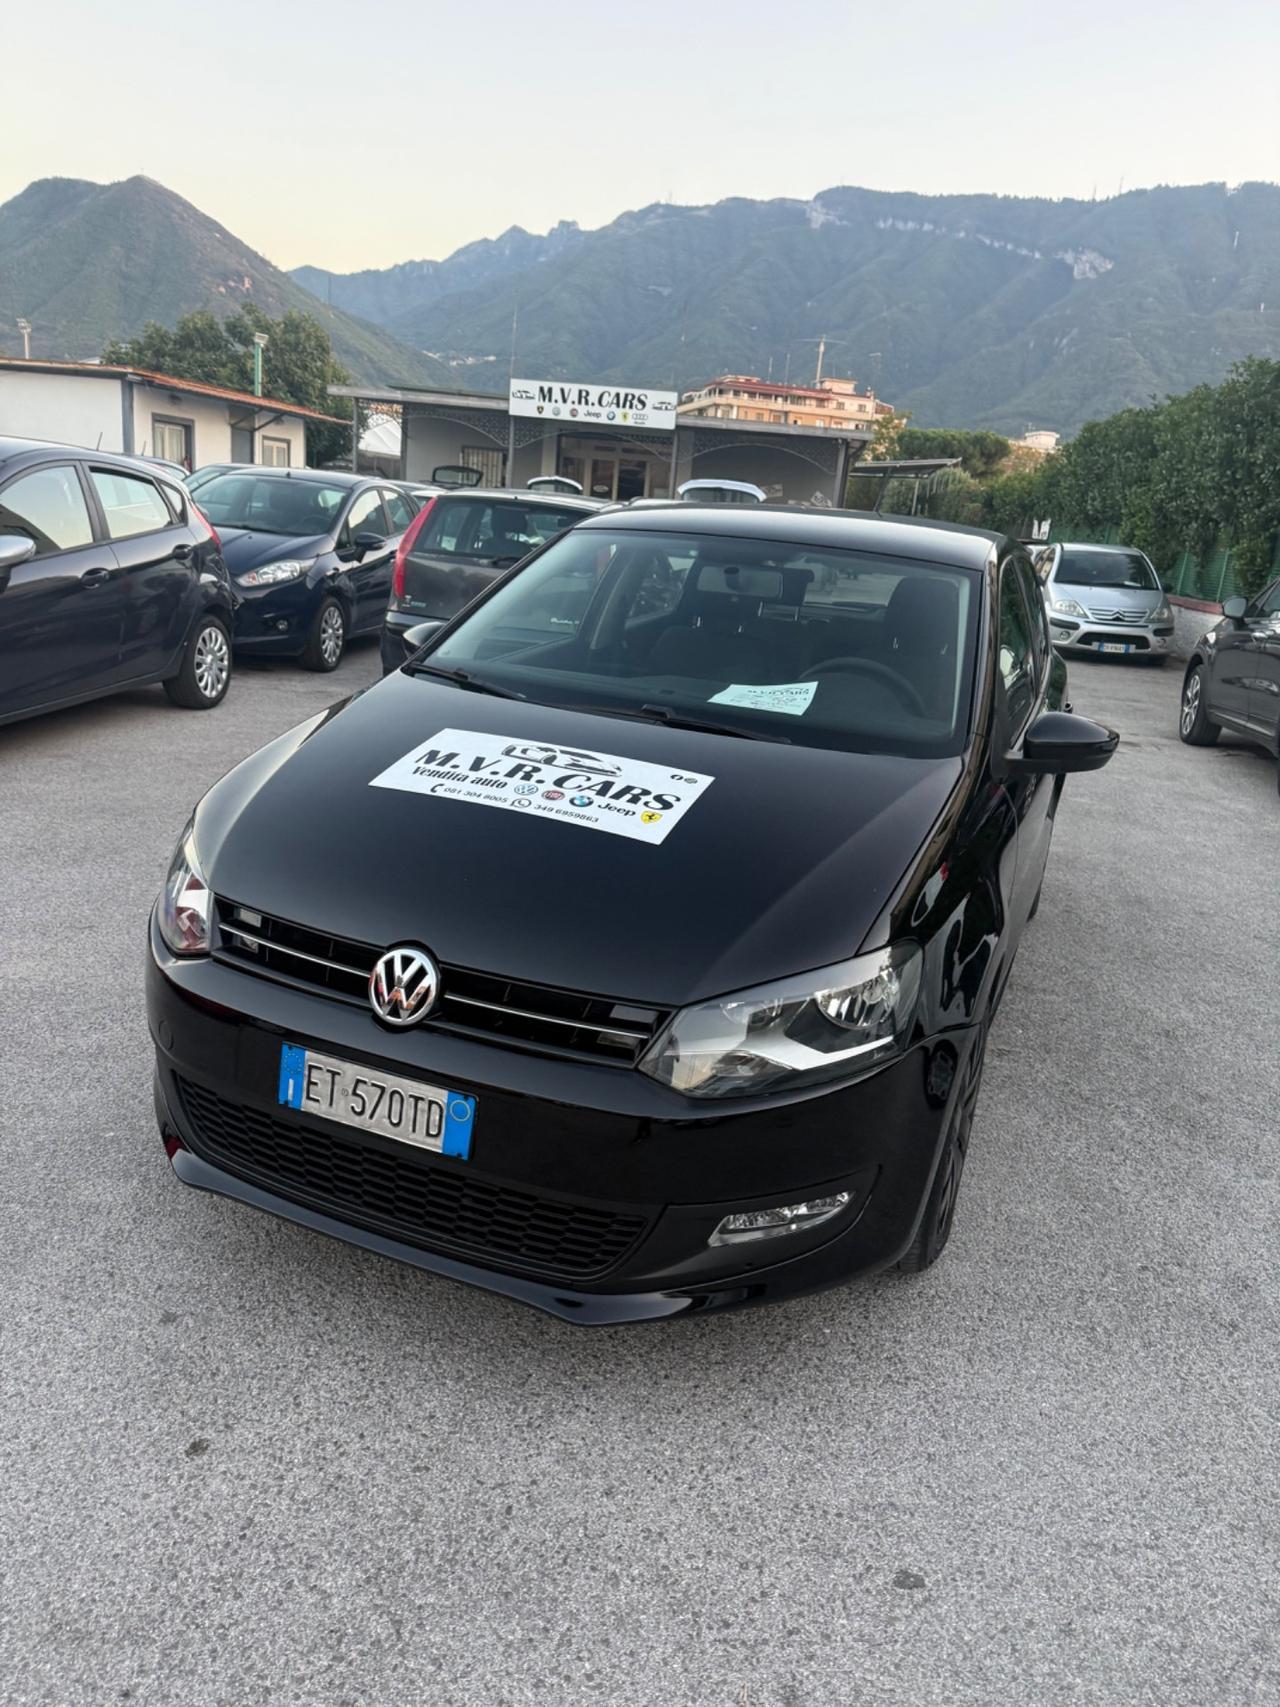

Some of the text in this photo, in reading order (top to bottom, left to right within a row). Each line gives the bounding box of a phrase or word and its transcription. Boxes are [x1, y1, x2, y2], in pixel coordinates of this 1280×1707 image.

[412, 766, 508, 789] Vendita auto
[534, 804, 555, 813] 349
[597, 802, 637, 817] Jeep
[305, 1063, 444, 1138] ET 570TD
